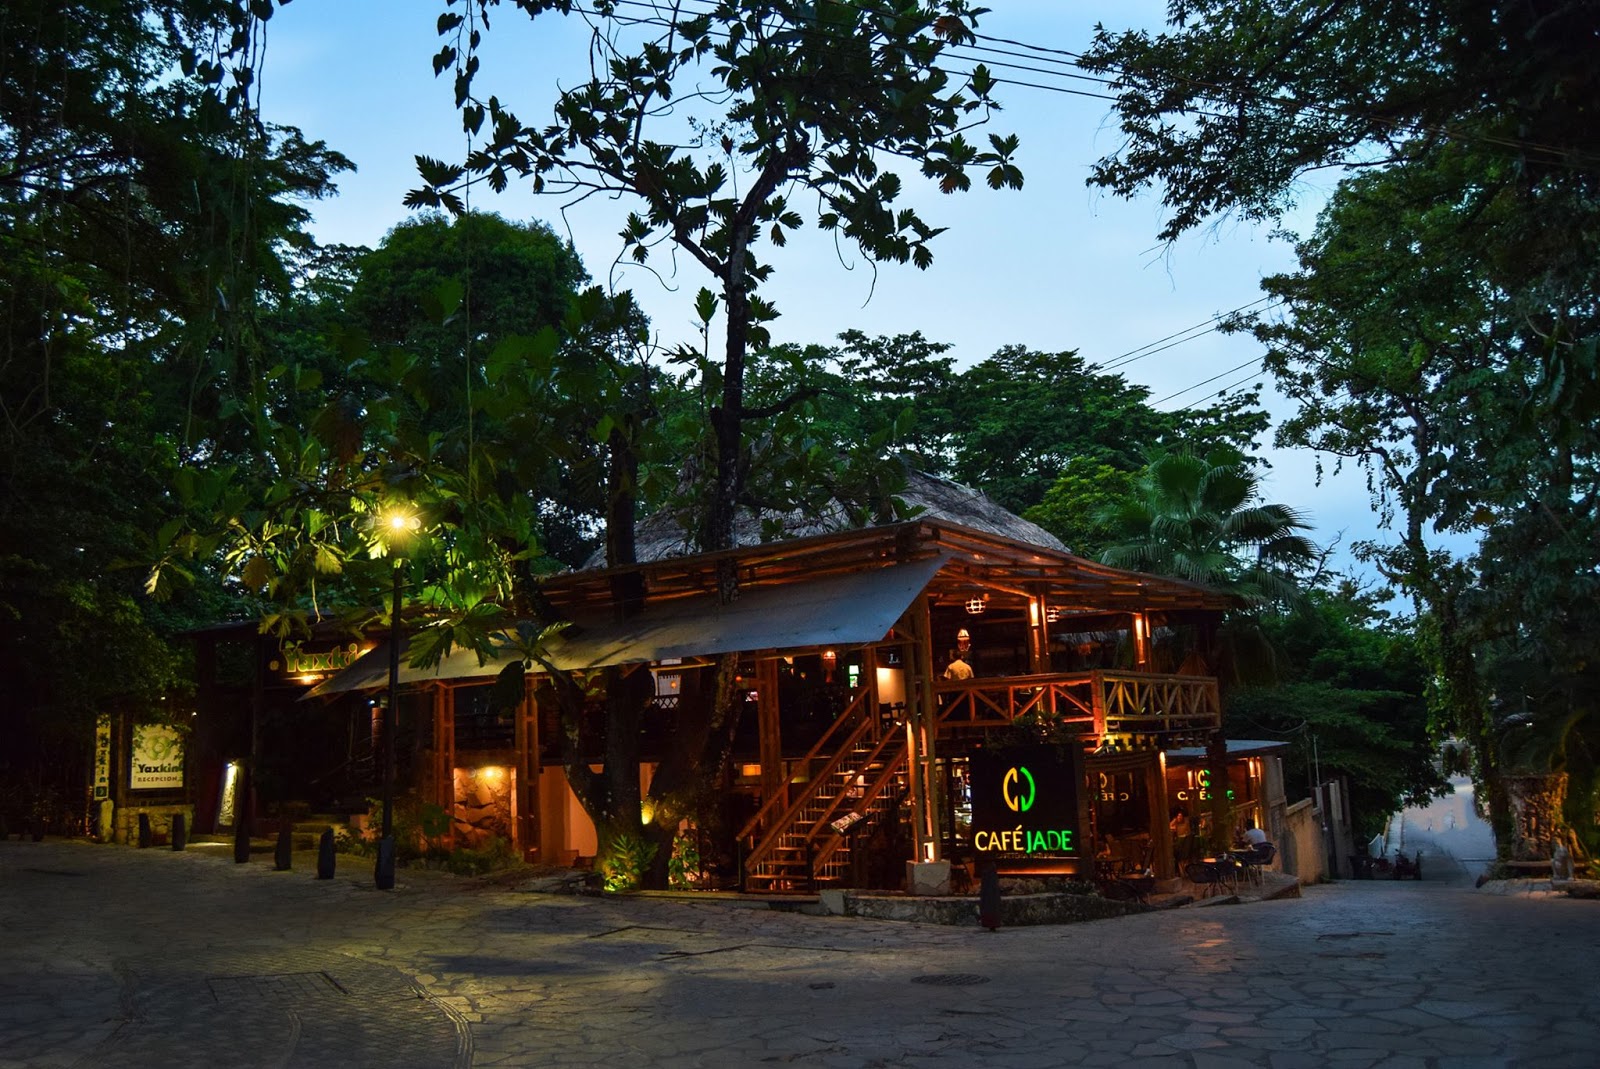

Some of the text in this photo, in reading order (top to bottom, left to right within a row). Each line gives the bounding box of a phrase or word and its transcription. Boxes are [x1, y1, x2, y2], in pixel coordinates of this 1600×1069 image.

[282, 642, 371, 673] Yaxki
[138, 763, 181, 774] Yaxkin
[974, 824, 1073, 855] CAFÉ JADE
